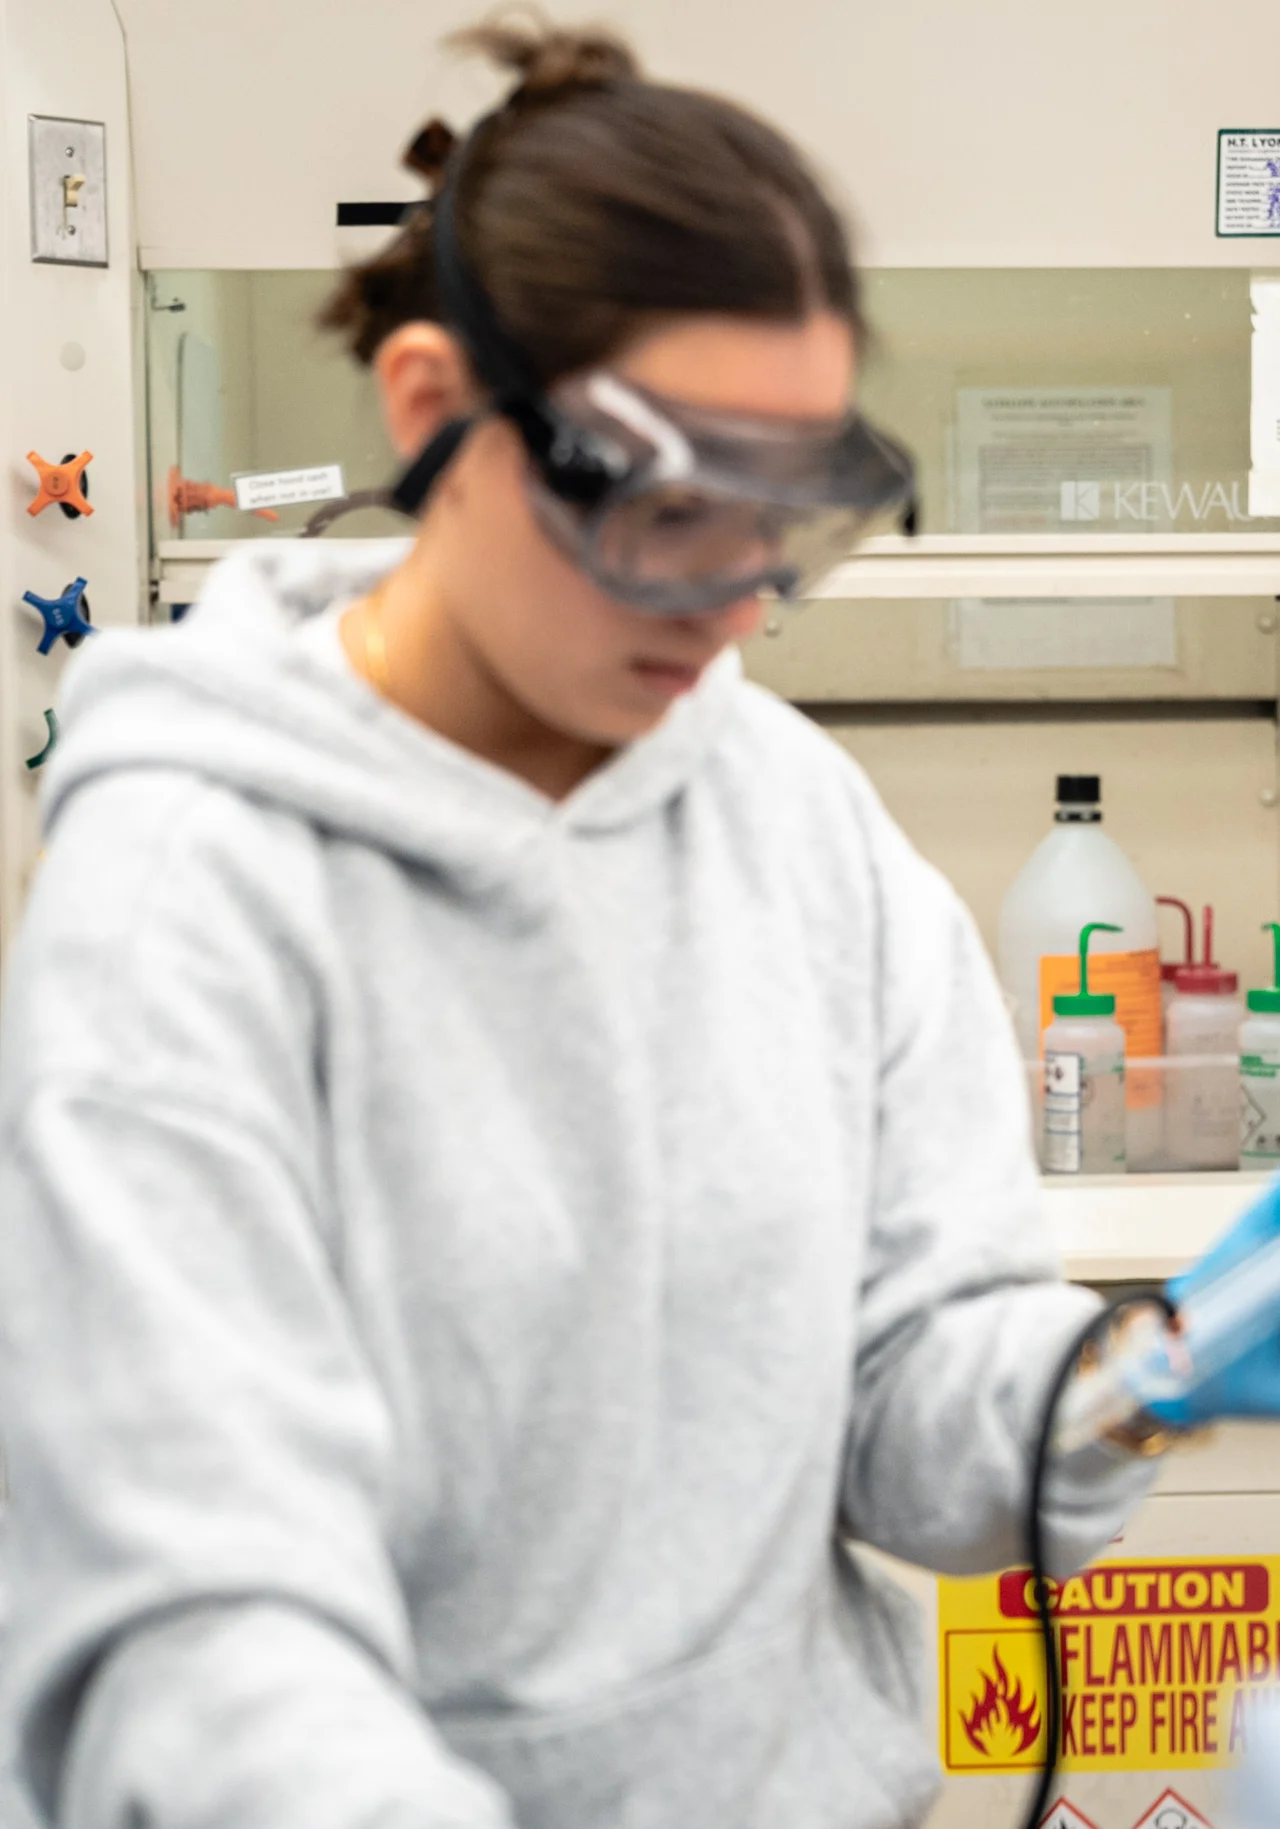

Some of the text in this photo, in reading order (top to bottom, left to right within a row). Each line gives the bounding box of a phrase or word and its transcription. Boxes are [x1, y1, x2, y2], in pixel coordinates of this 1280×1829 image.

[1023, 1571, 1246, 1612] CAUTION
[1062, 1688, 1138, 1757] KEEP
[1150, 1690, 1219, 1756] FIRE
